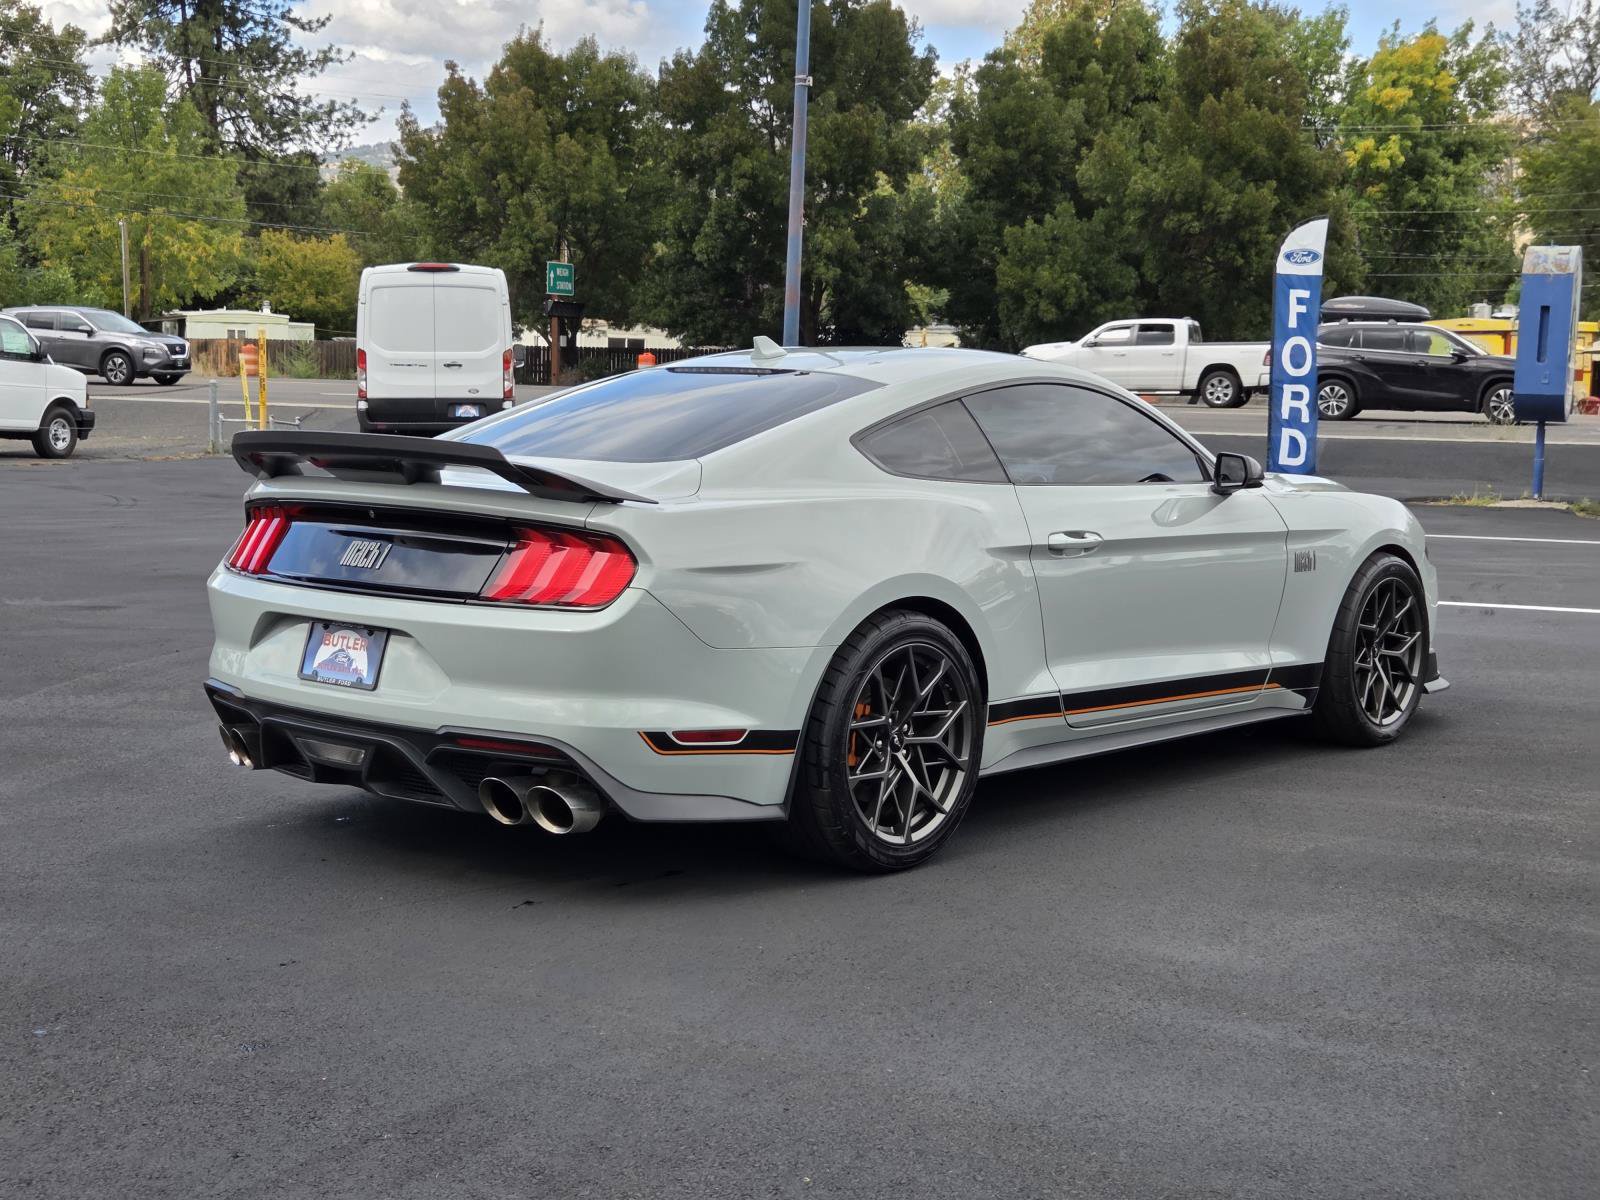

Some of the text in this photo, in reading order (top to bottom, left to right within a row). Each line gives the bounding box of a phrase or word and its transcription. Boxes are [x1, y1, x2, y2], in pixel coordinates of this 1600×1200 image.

[1278, 288, 1313, 467] FORD
[322, 631, 368, 652] BUTLER
[337, 679, 352, 687] FORD
